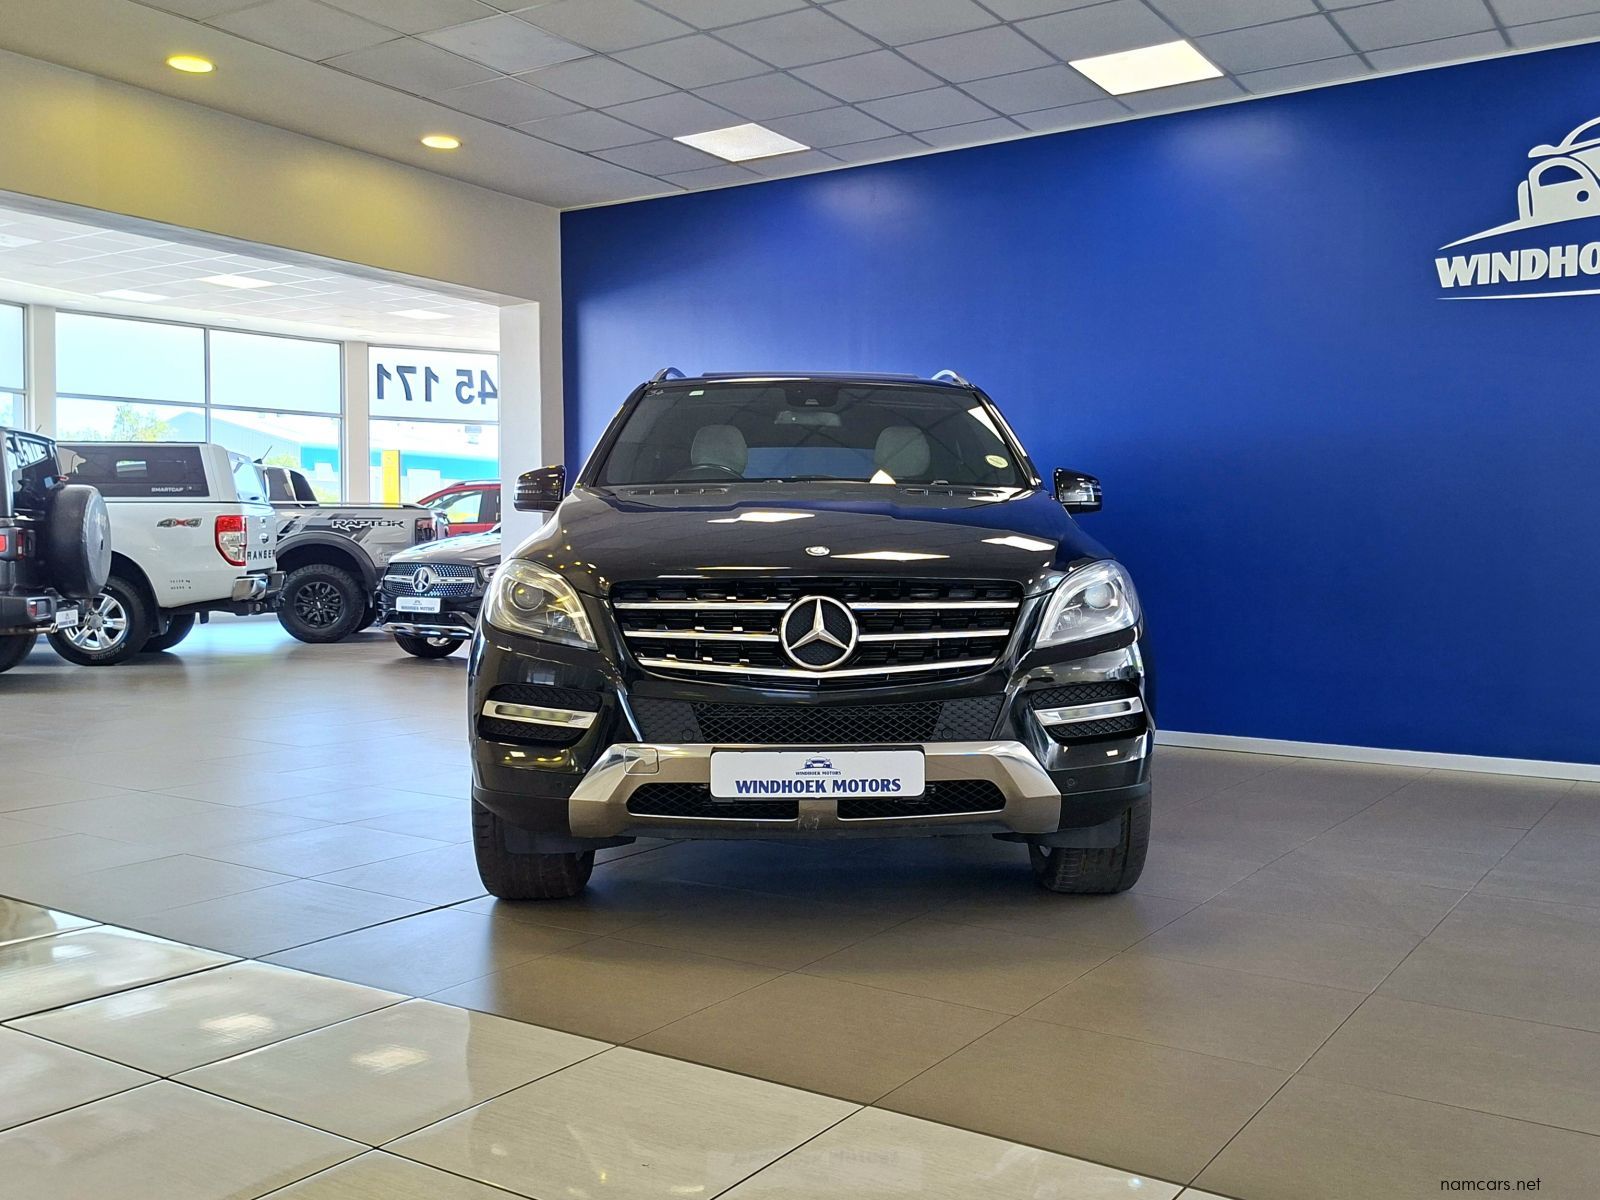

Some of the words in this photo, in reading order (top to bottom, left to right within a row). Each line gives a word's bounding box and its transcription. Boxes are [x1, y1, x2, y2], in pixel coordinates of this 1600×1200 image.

[1435, 241, 1600, 288] WINDHO
[331, 519, 406, 531] RAPTOR
[735, 779, 827, 794] WINDHOEK
[832, 778, 901, 793] MOTORS
